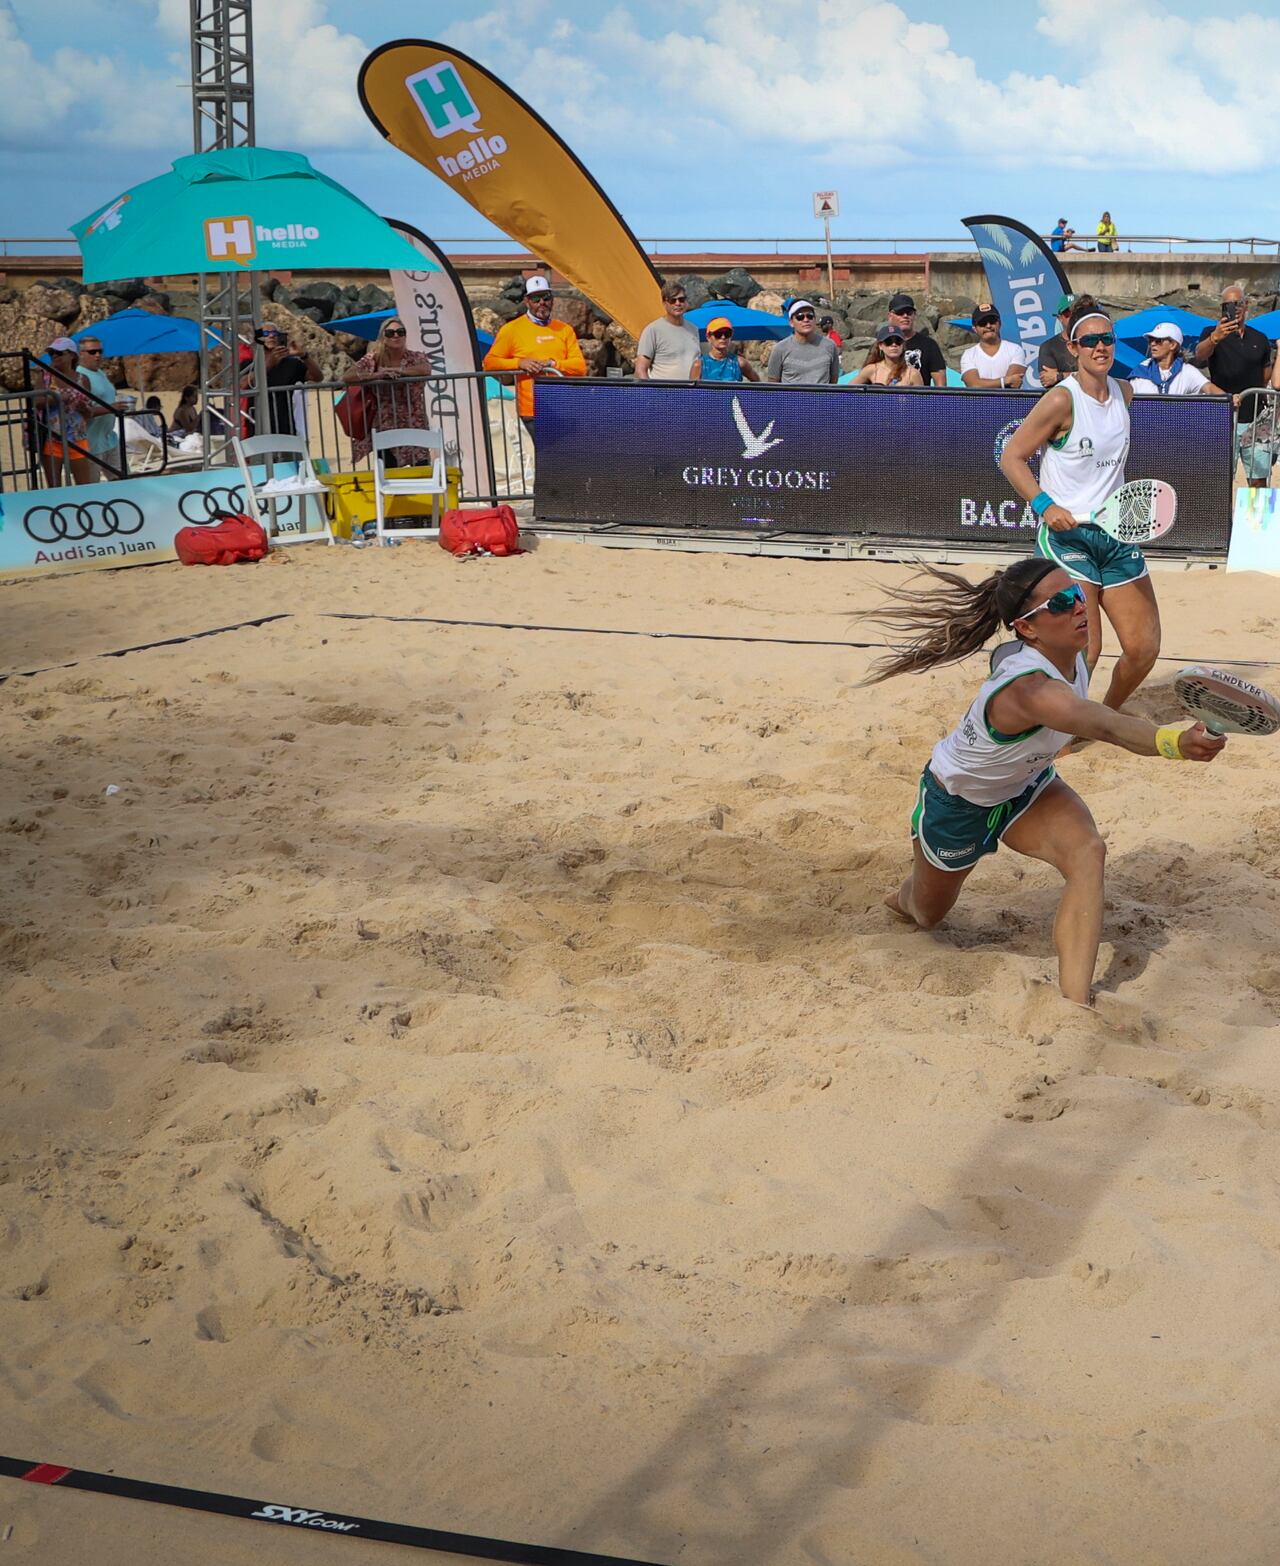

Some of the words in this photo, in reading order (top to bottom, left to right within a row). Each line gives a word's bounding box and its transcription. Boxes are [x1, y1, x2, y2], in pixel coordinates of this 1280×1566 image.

[436, 135, 508, 177] hello
[462, 159, 501, 182] MEDIA
[256, 223, 319, 241] hello
[271, 240, 308, 248] MEDIA
[682, 466, 743, 487] GREY
[747, 469, 832, 491] GOOSE
[961, 498, 1037, 528] BACA
[35, 546, 84, 564] Audi
[86, 544, 116, 558] San
[119, 541, 156, 556] Juan
[250, 1504, 361, 1531] SXY.COM
